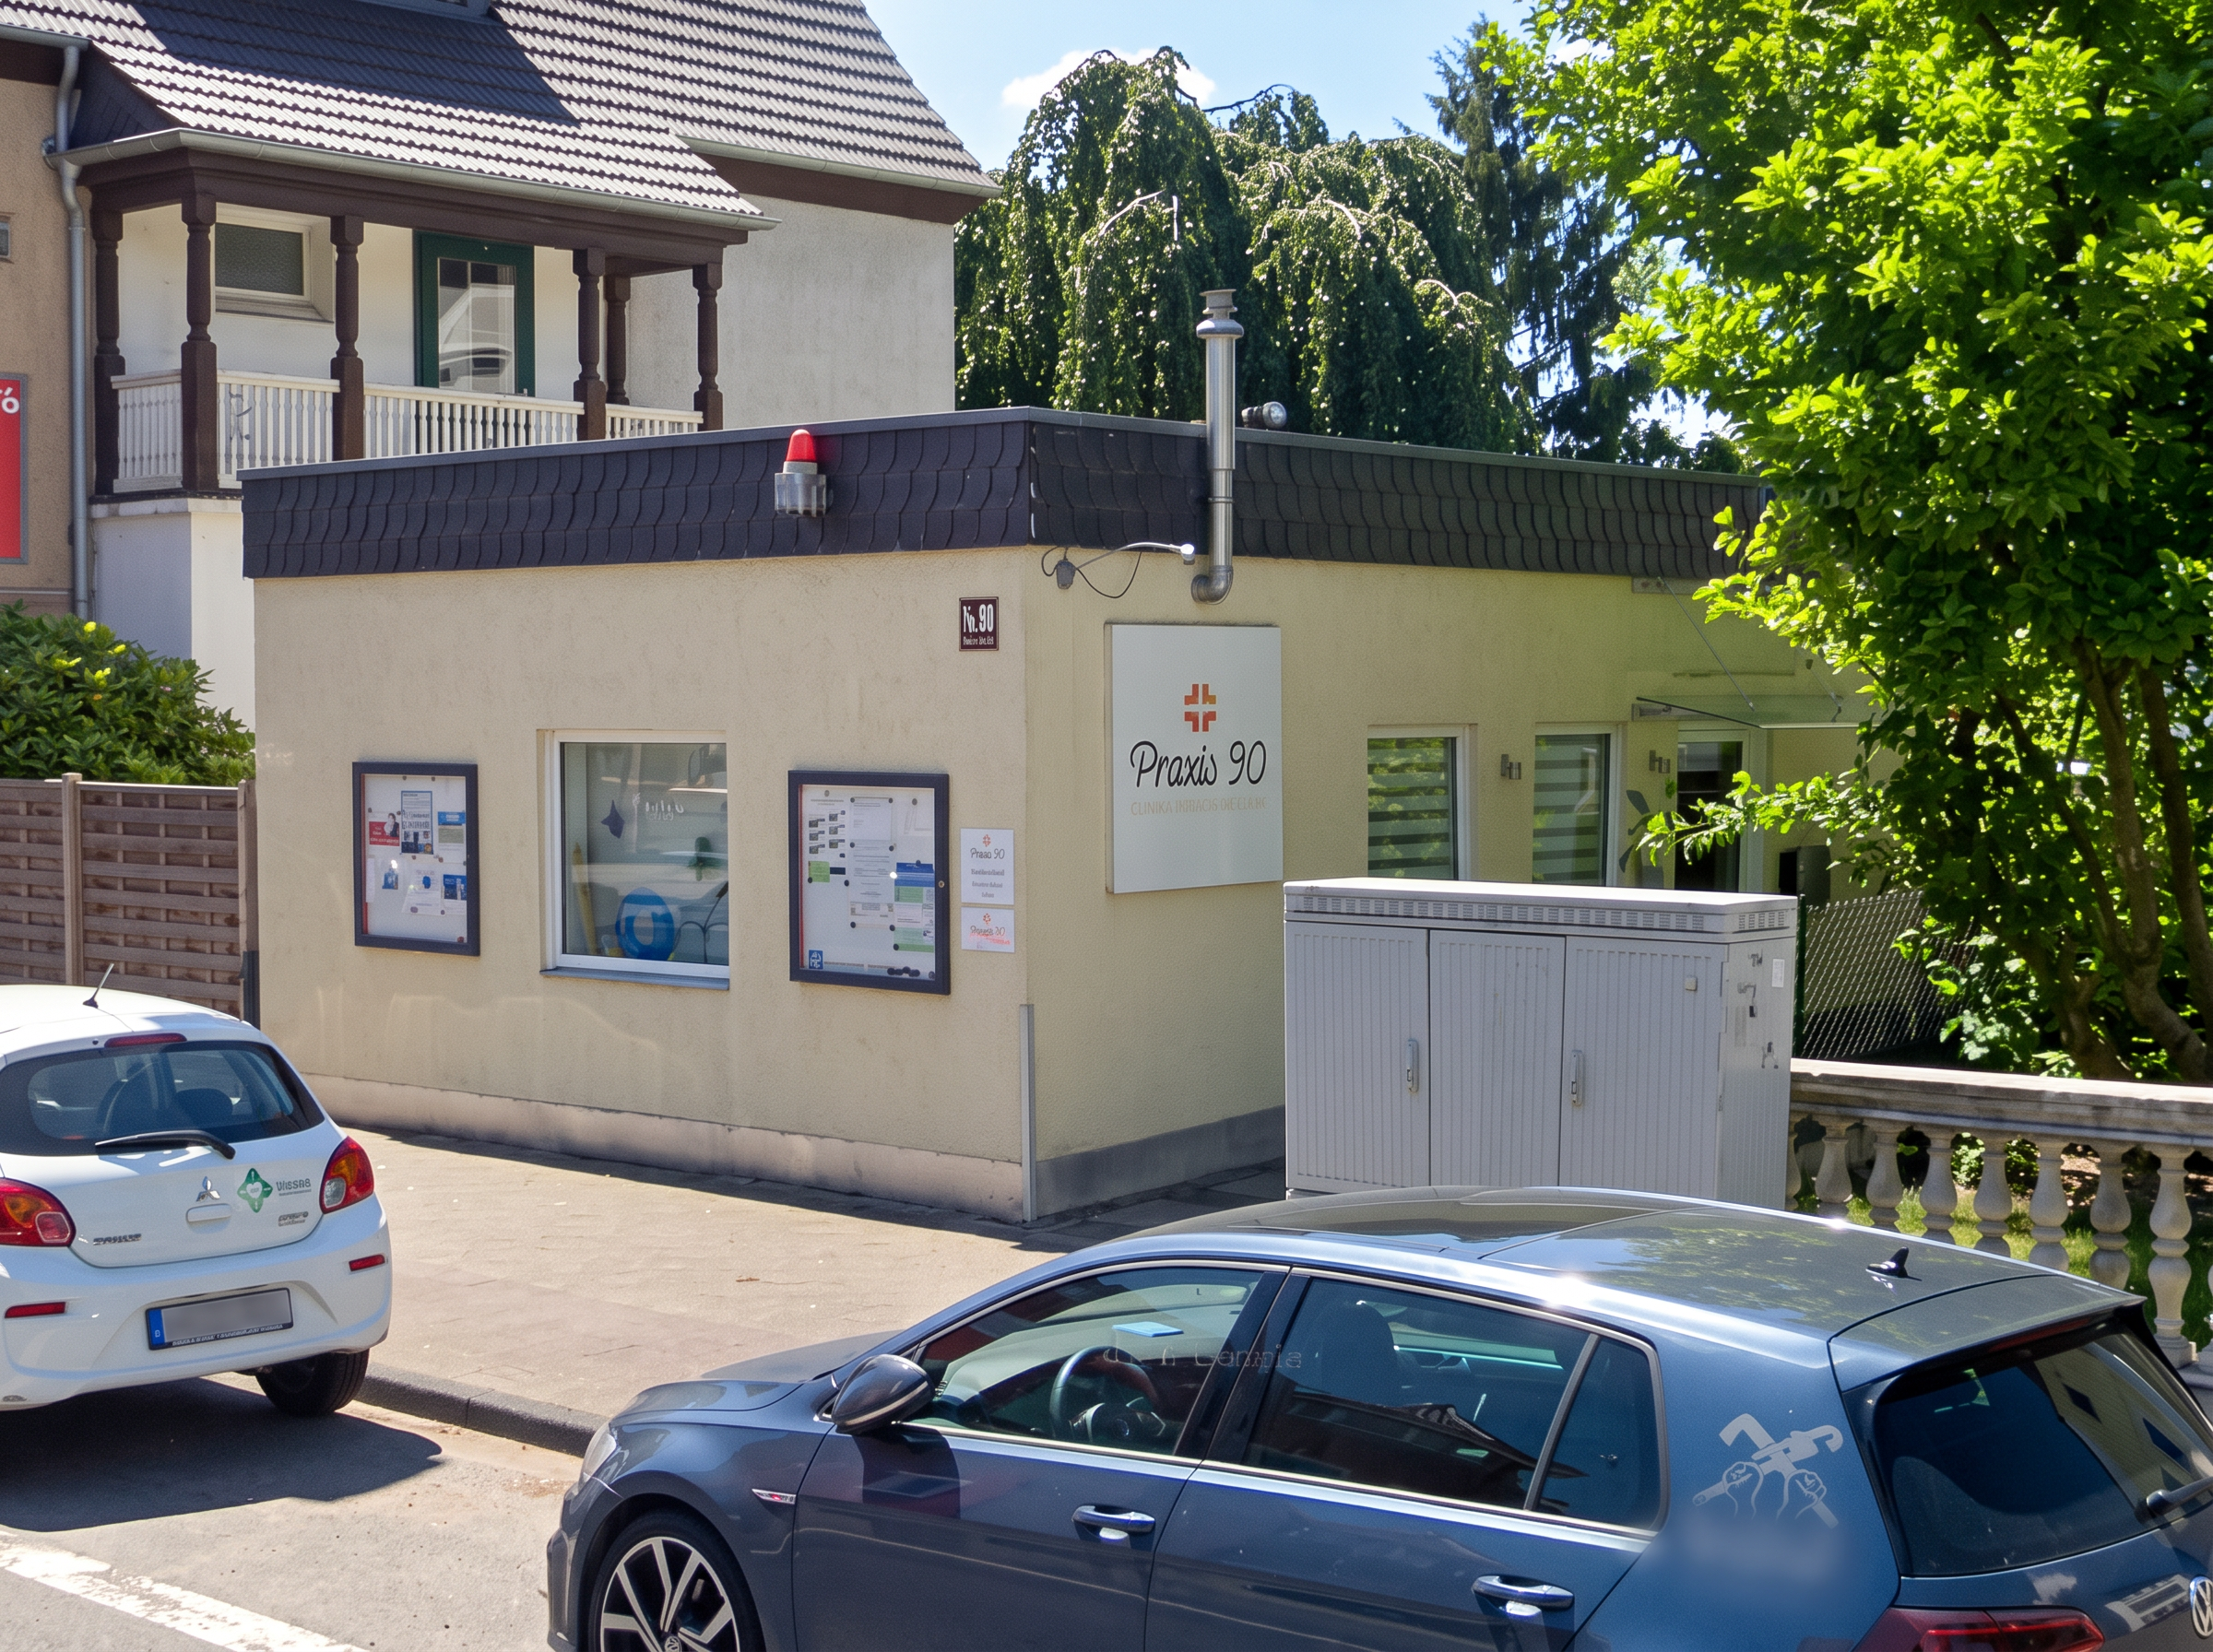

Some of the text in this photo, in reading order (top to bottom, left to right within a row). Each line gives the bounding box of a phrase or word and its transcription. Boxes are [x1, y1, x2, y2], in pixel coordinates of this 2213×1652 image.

[1130, 740, 1267, 788] Praxis 90
[993, 847, 1005, 859] 90
